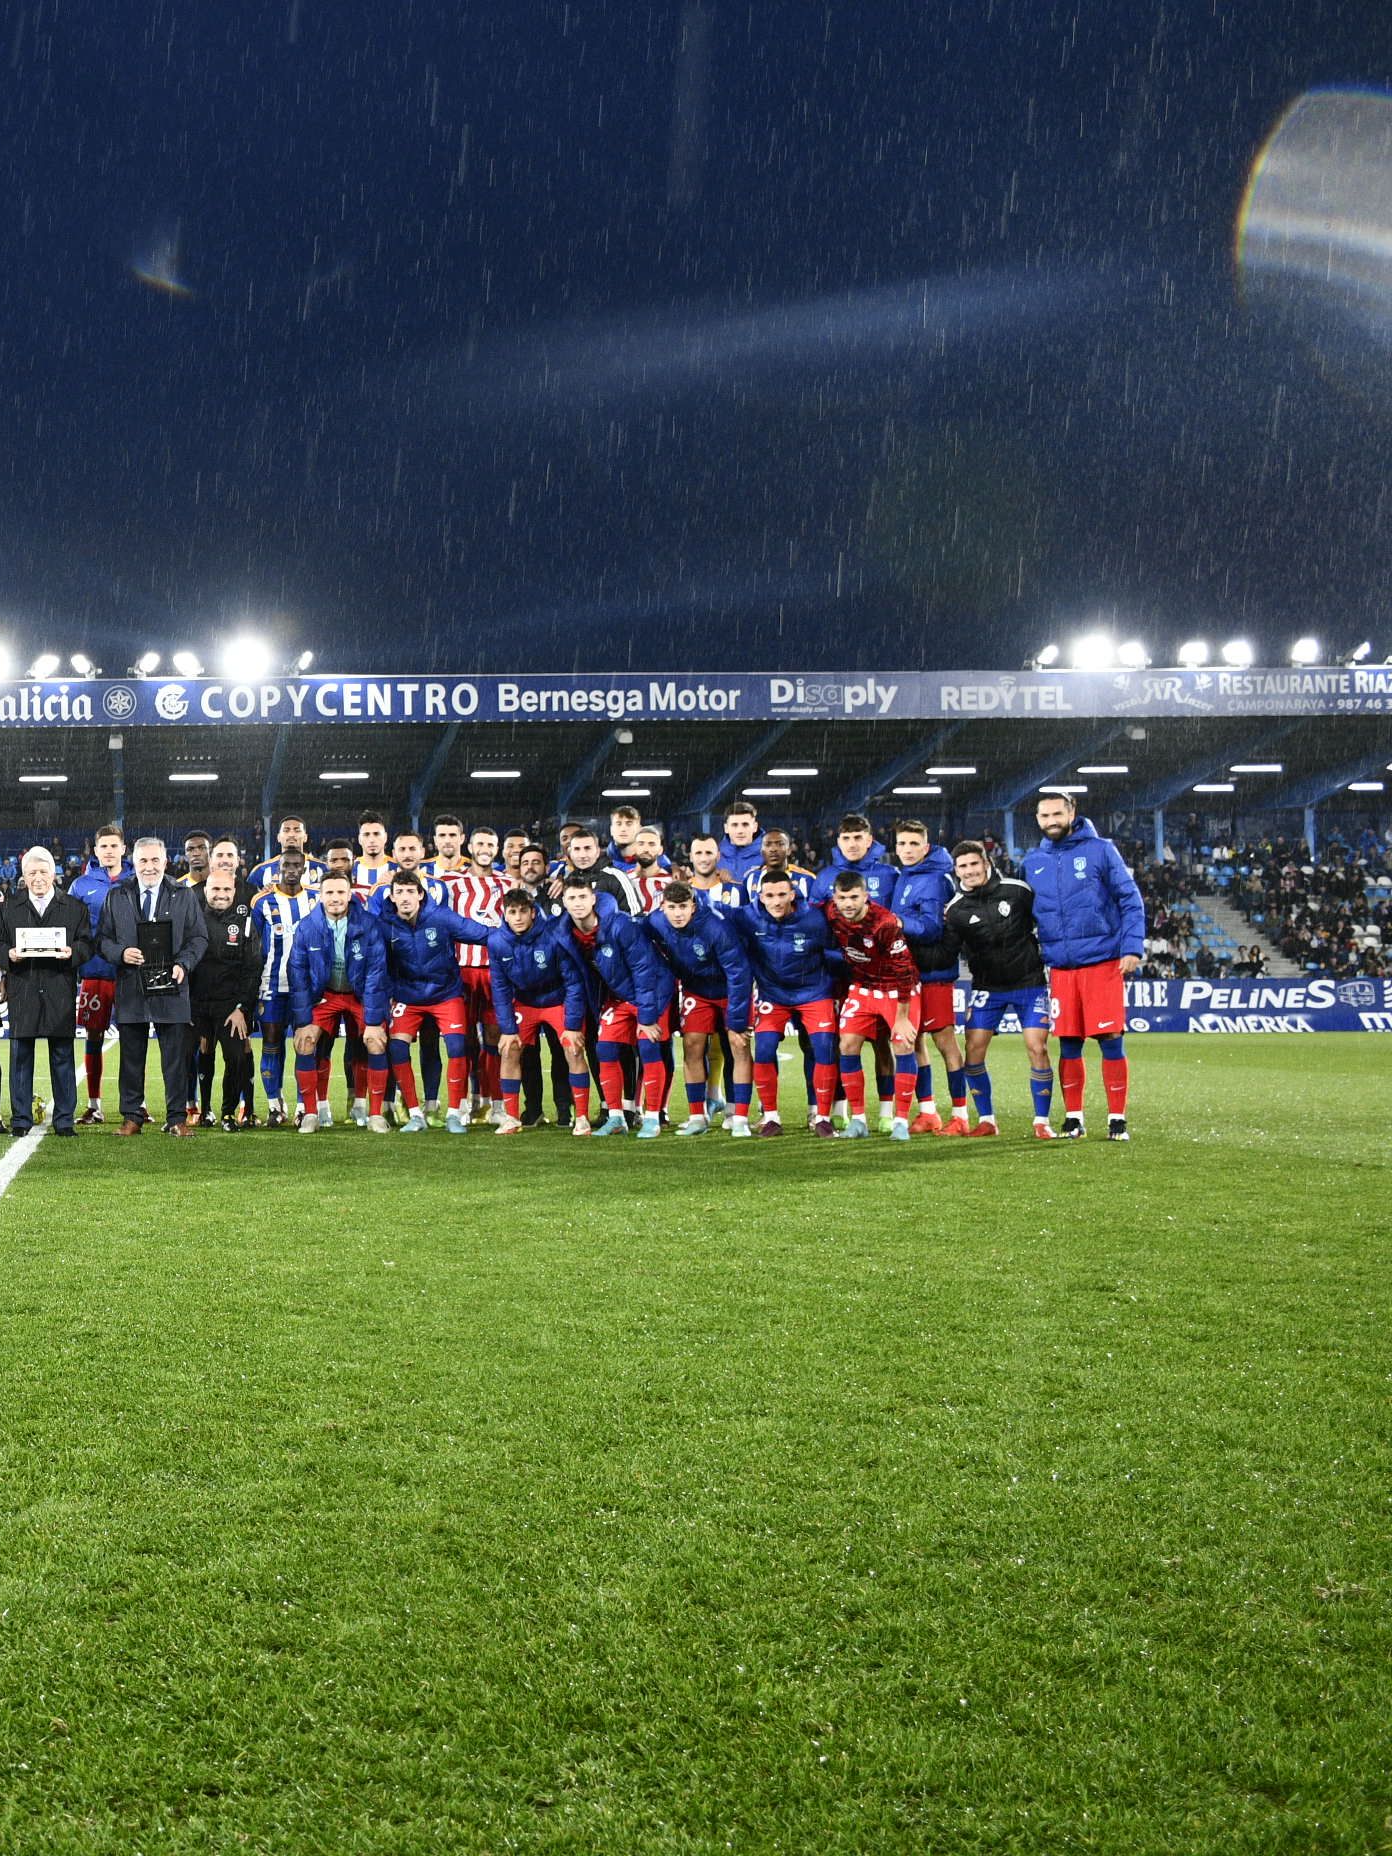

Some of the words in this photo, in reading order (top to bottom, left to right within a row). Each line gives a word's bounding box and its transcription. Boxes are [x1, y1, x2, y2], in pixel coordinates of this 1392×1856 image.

[770, 679, 898, 714] Disaply
[940, 686, 1073, 711] REDYTEL
[1218, 672, 1350, 696] RESTAURANTE
[200, 682, 479, 718] COPYCENTRO
[498, 683, 643, 718] Bernesga
[649, 682, 740, 711] Motor
[79, 991, 101, 1010] 36
